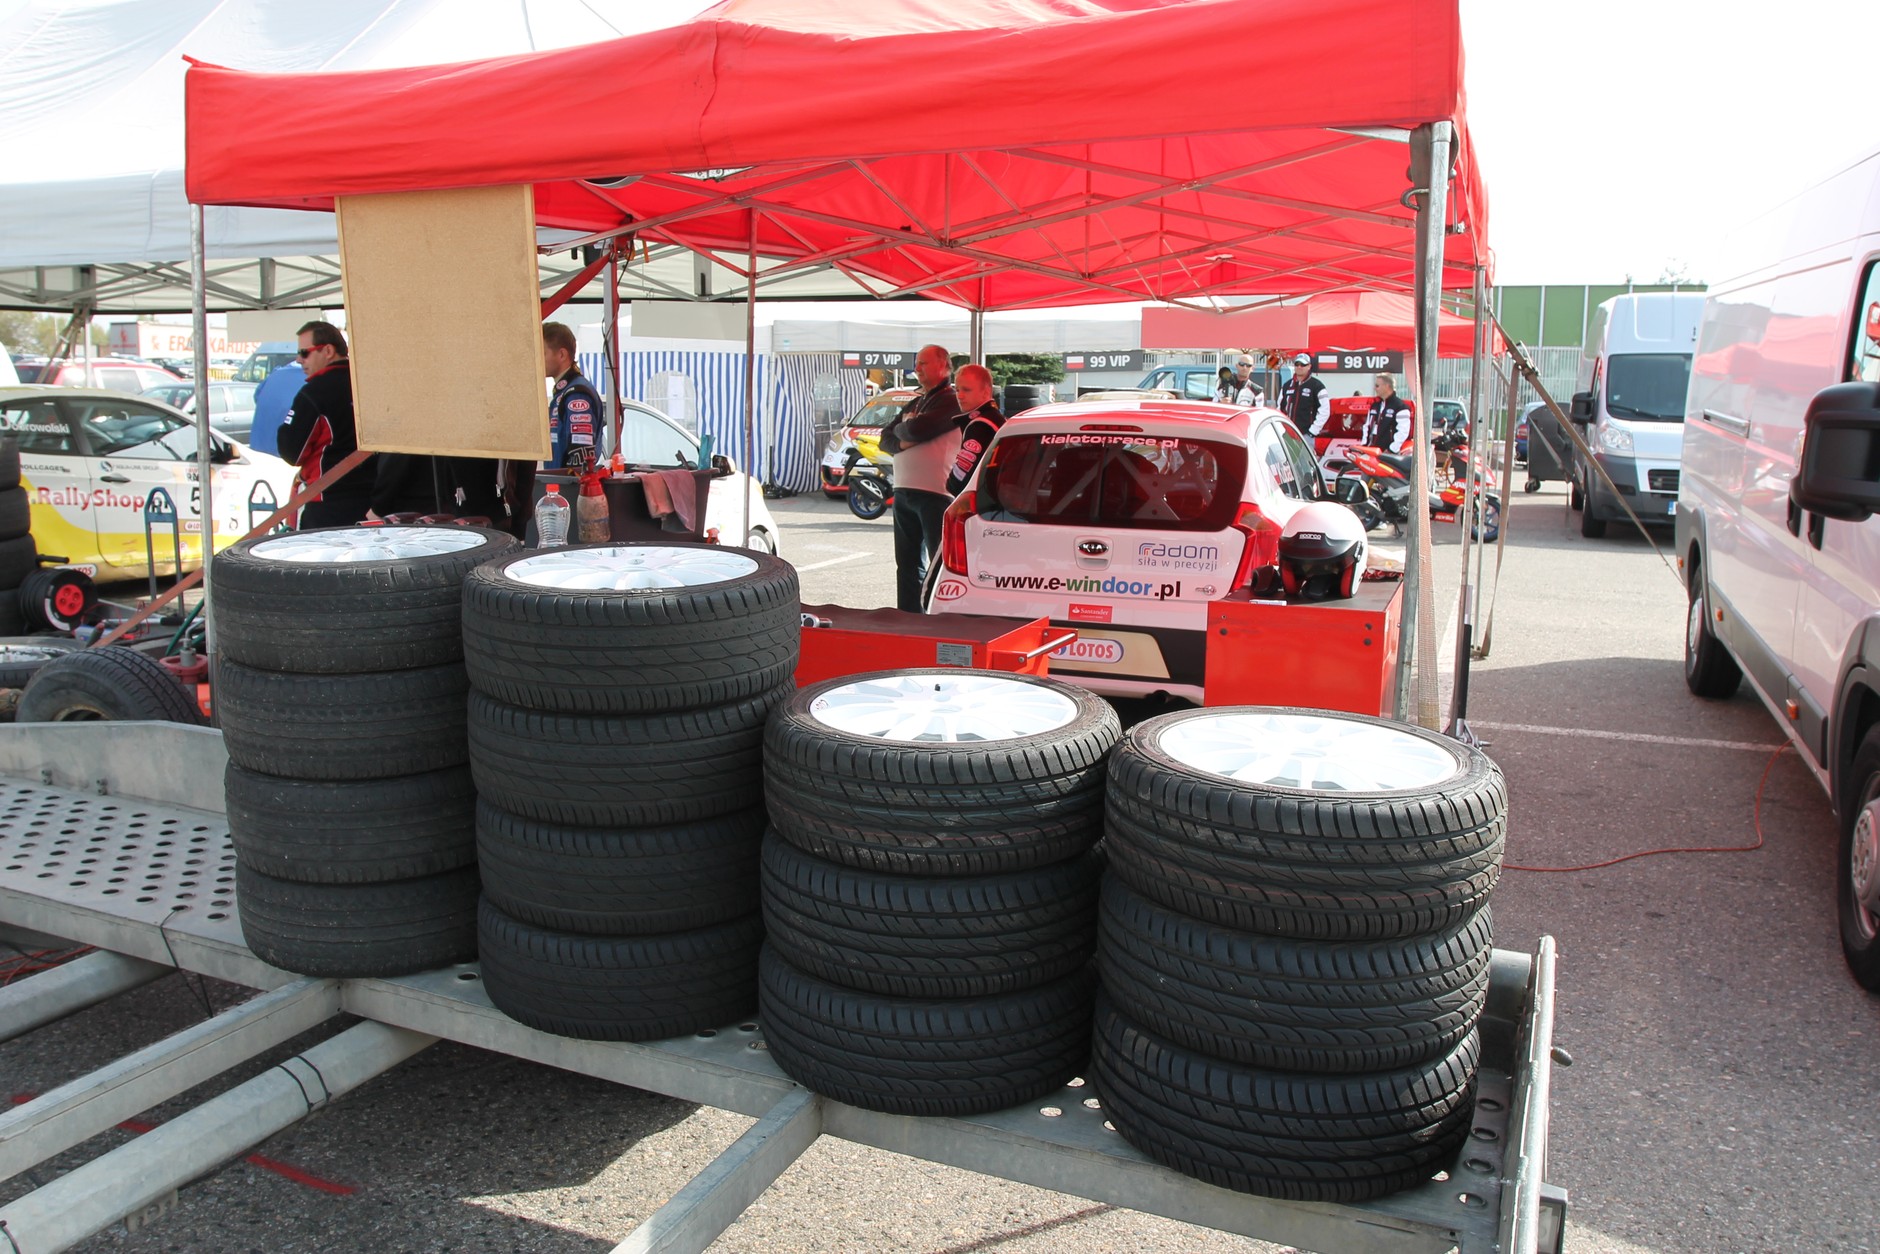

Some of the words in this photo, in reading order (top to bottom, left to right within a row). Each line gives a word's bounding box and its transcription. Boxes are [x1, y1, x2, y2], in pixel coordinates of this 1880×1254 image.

[864, 354, 879, 365] 97
[883, 354, 902, 365] VIP
[1090, 356, 1106, 368] 99
[1109, 355, 1131, 367] VIP
[1344, 356, 1362, 369] 98
[1366, 356, 1390, 369] VIP
[572, 402, 586, 410] KIA
[966, 442, 979, 451] KIA
[1082, 542, 1103, 552] KIA
[1138, 557, 1157, 567] siła
[1174, 560, 1218, 572] precyzji
[938, 584, 960, 596] KIA
[1080, 608, 1109, 617] Santander
[1069, 643, 1114, 659] LOTOS
